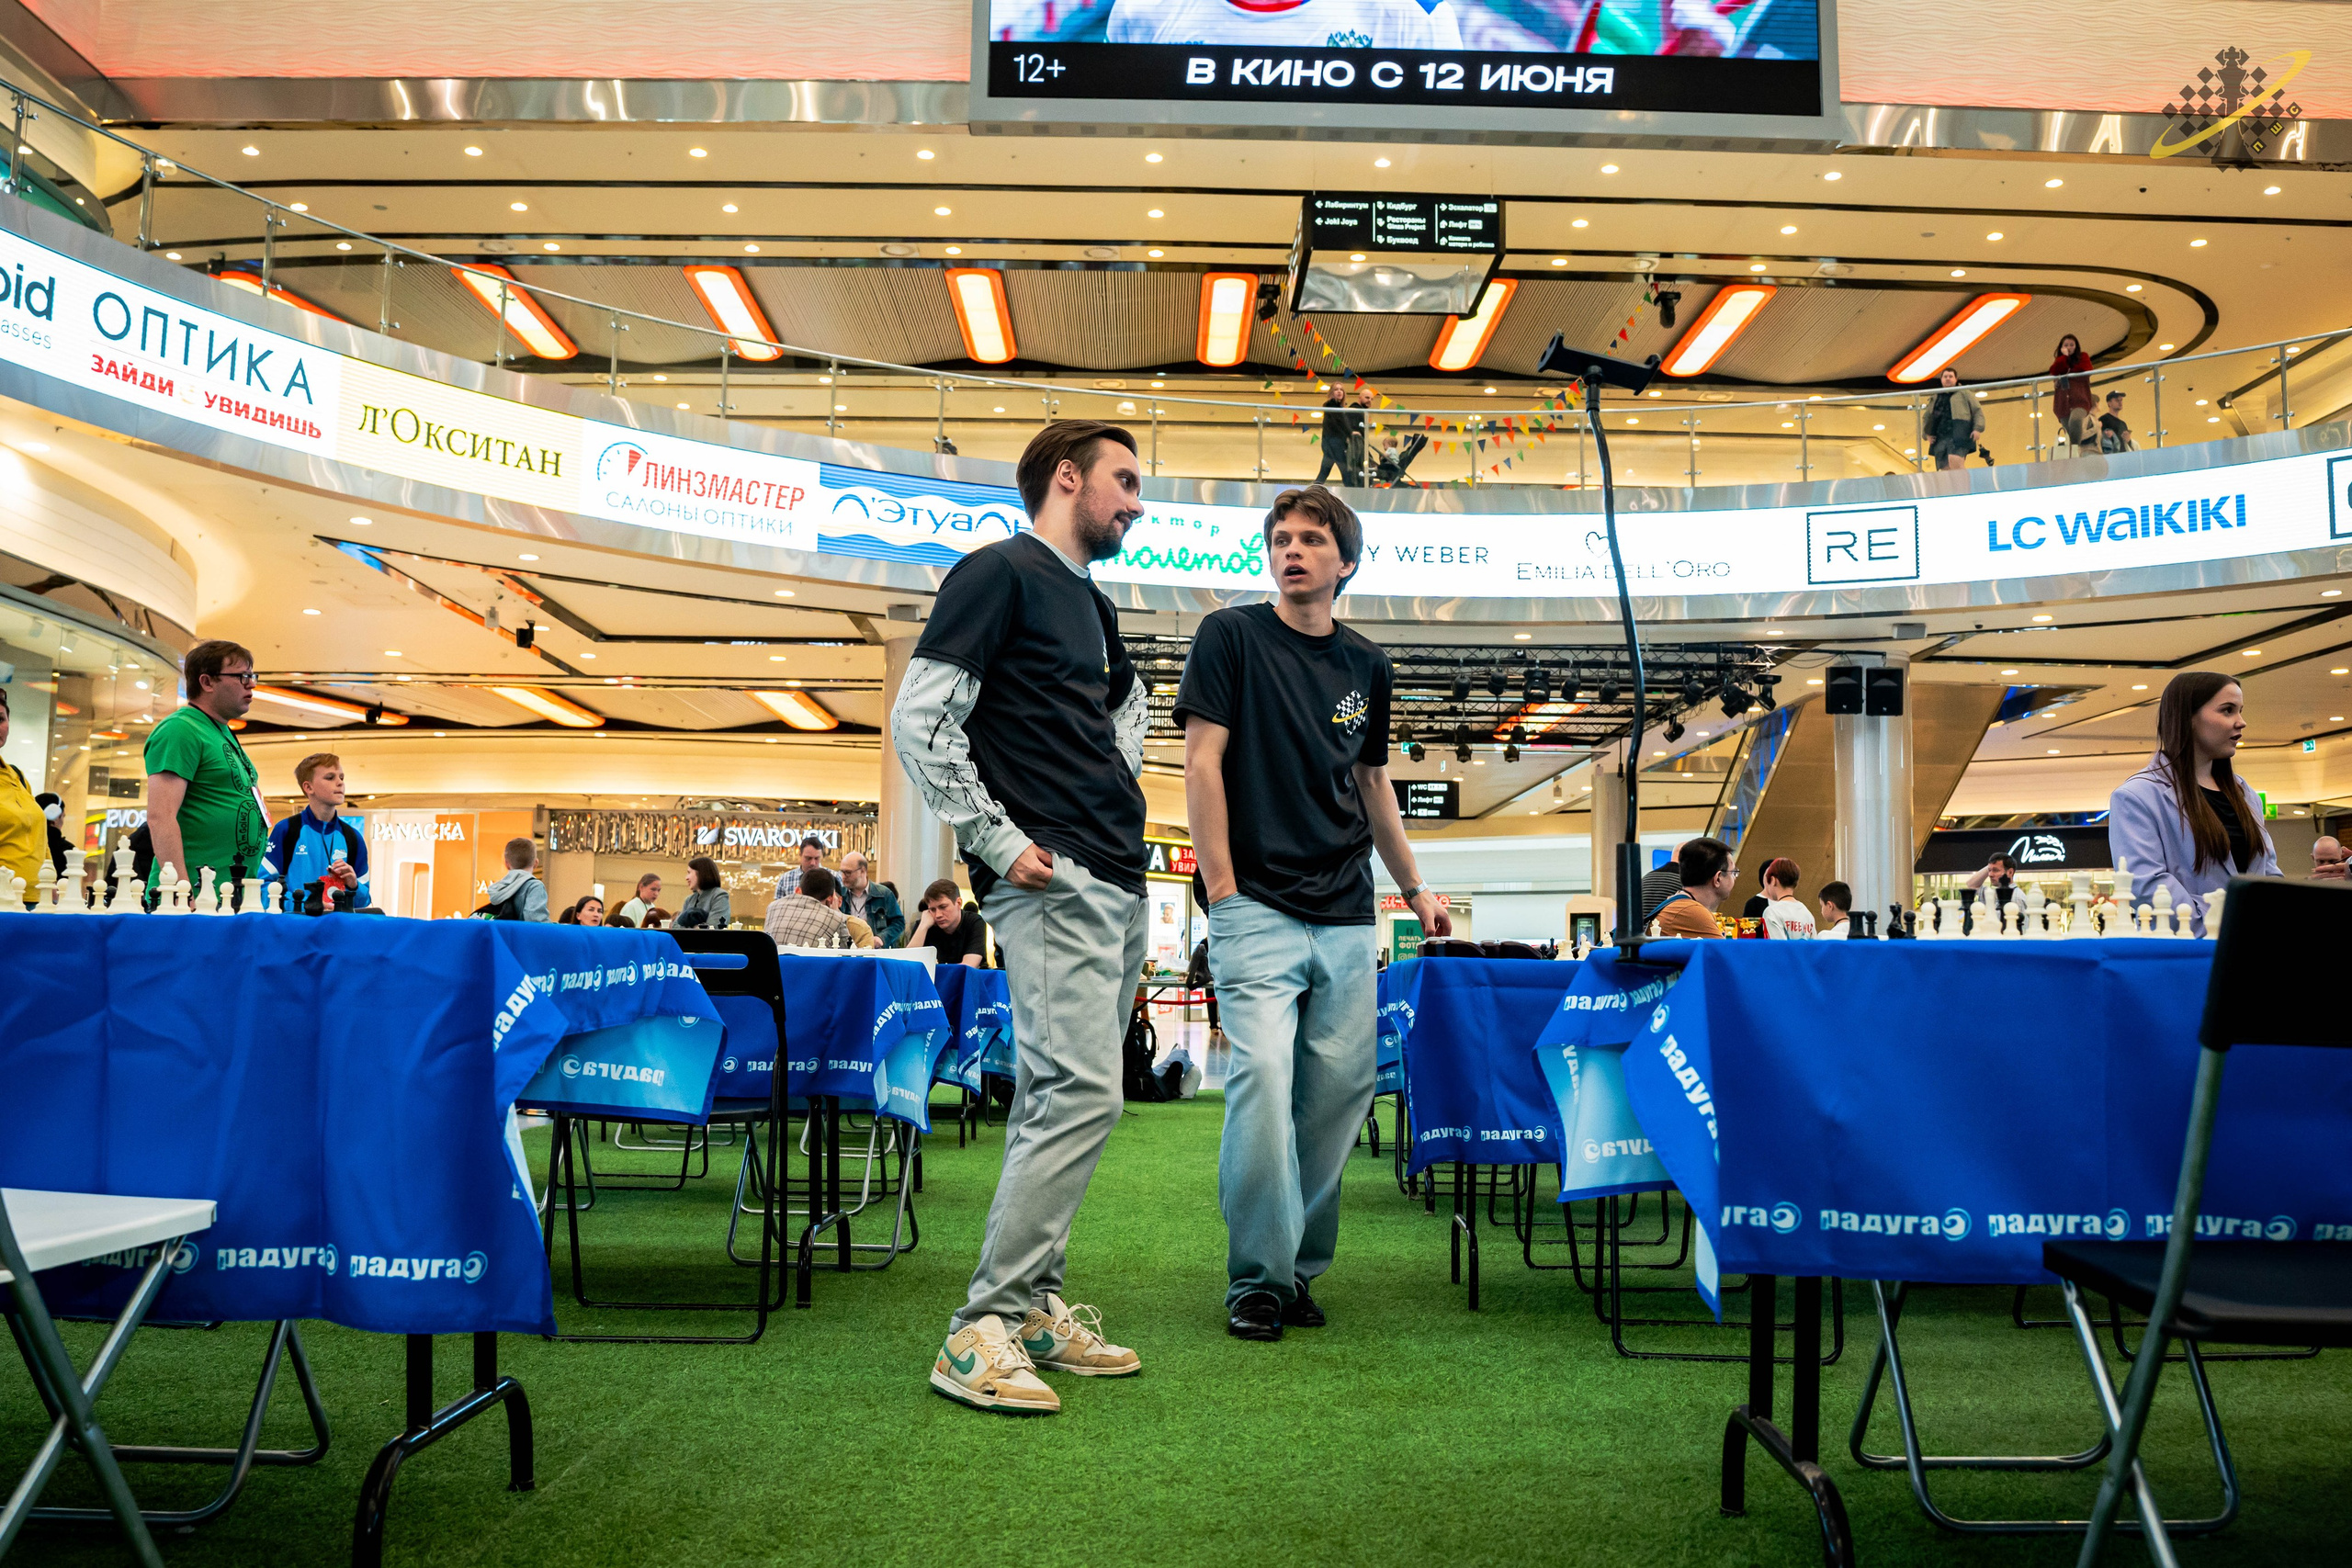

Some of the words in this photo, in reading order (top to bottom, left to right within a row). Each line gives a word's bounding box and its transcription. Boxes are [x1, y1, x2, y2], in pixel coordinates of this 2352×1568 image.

[1013, 55, 1066, 84] 12+
[1186, 57, 1216, 85] В
[1231, 58, 1355, 88] КИНО
[1370, 61, 1404, 89] С
[1419, 62, 1464, 90] 12
[1480, 64, 1614, 95] ИЮНЯ
[1386, 202, 1418, 211] Кидбург
[1386, 216, 1426, 224] Рестораны
[1448, 204, 1484, 212] Эскалатор
[1340, 218, 1358, 226] Joya
[93, 291, 313, 405] ОПТИКА
[91, 354, 175, 397] ЗАЙДИ
[642, 461, 805, 511] ЛИНЗМАСТЕР
[605, 491, 698, 522] САЛОНЫ
[704, 508, 793, 536] ОПТИКИ
[1133, 515, 1220, 537] ктор
[1826, 527, 1899, 564] RE
[1987, 516, 2046, 552] LC
[1102, 532, 1264, 576] толетов
[1395, 546, 1488, 564] WEBER
[1171, 862, 1197, 873] УВИД
[1785, 920, 1802, 931] FREE
[747, 1060, 806, 1072] радга
[828, 1059, 873, 1073] радуг
[1481, 1128, 1533, 1142] радуга
[1820, 1208, 1939, 1235] радуга
[1988, 1212, 2102, 1236] радуга
[2145, 1214, 2263, 1238] рауга
[217, 1246, 326, 1270] радуга
[350, 1253, 460, 1280] радуга
